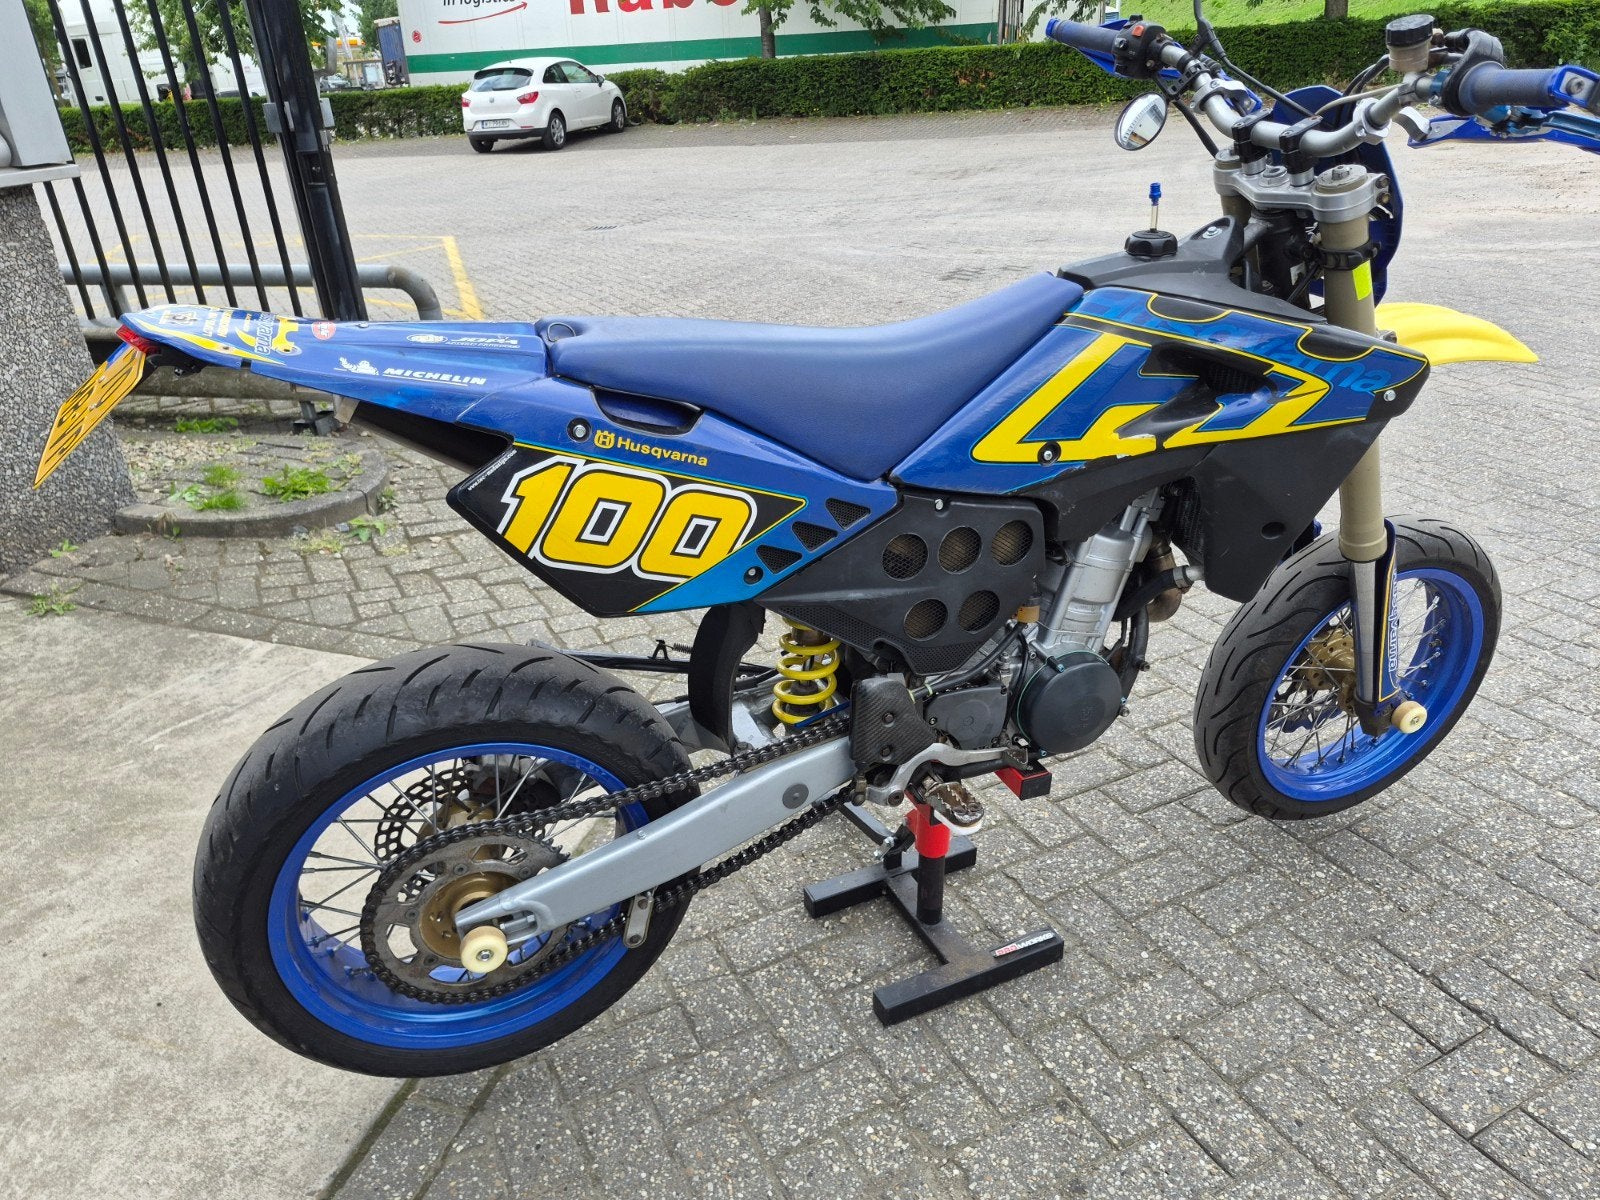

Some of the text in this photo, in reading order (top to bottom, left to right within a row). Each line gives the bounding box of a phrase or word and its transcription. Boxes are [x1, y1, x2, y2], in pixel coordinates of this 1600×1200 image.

[382, 367, 487, 386] MICHELIN
[616, 436, 709, 467] Husqvarna
[496, 455, 758, 583] 100
